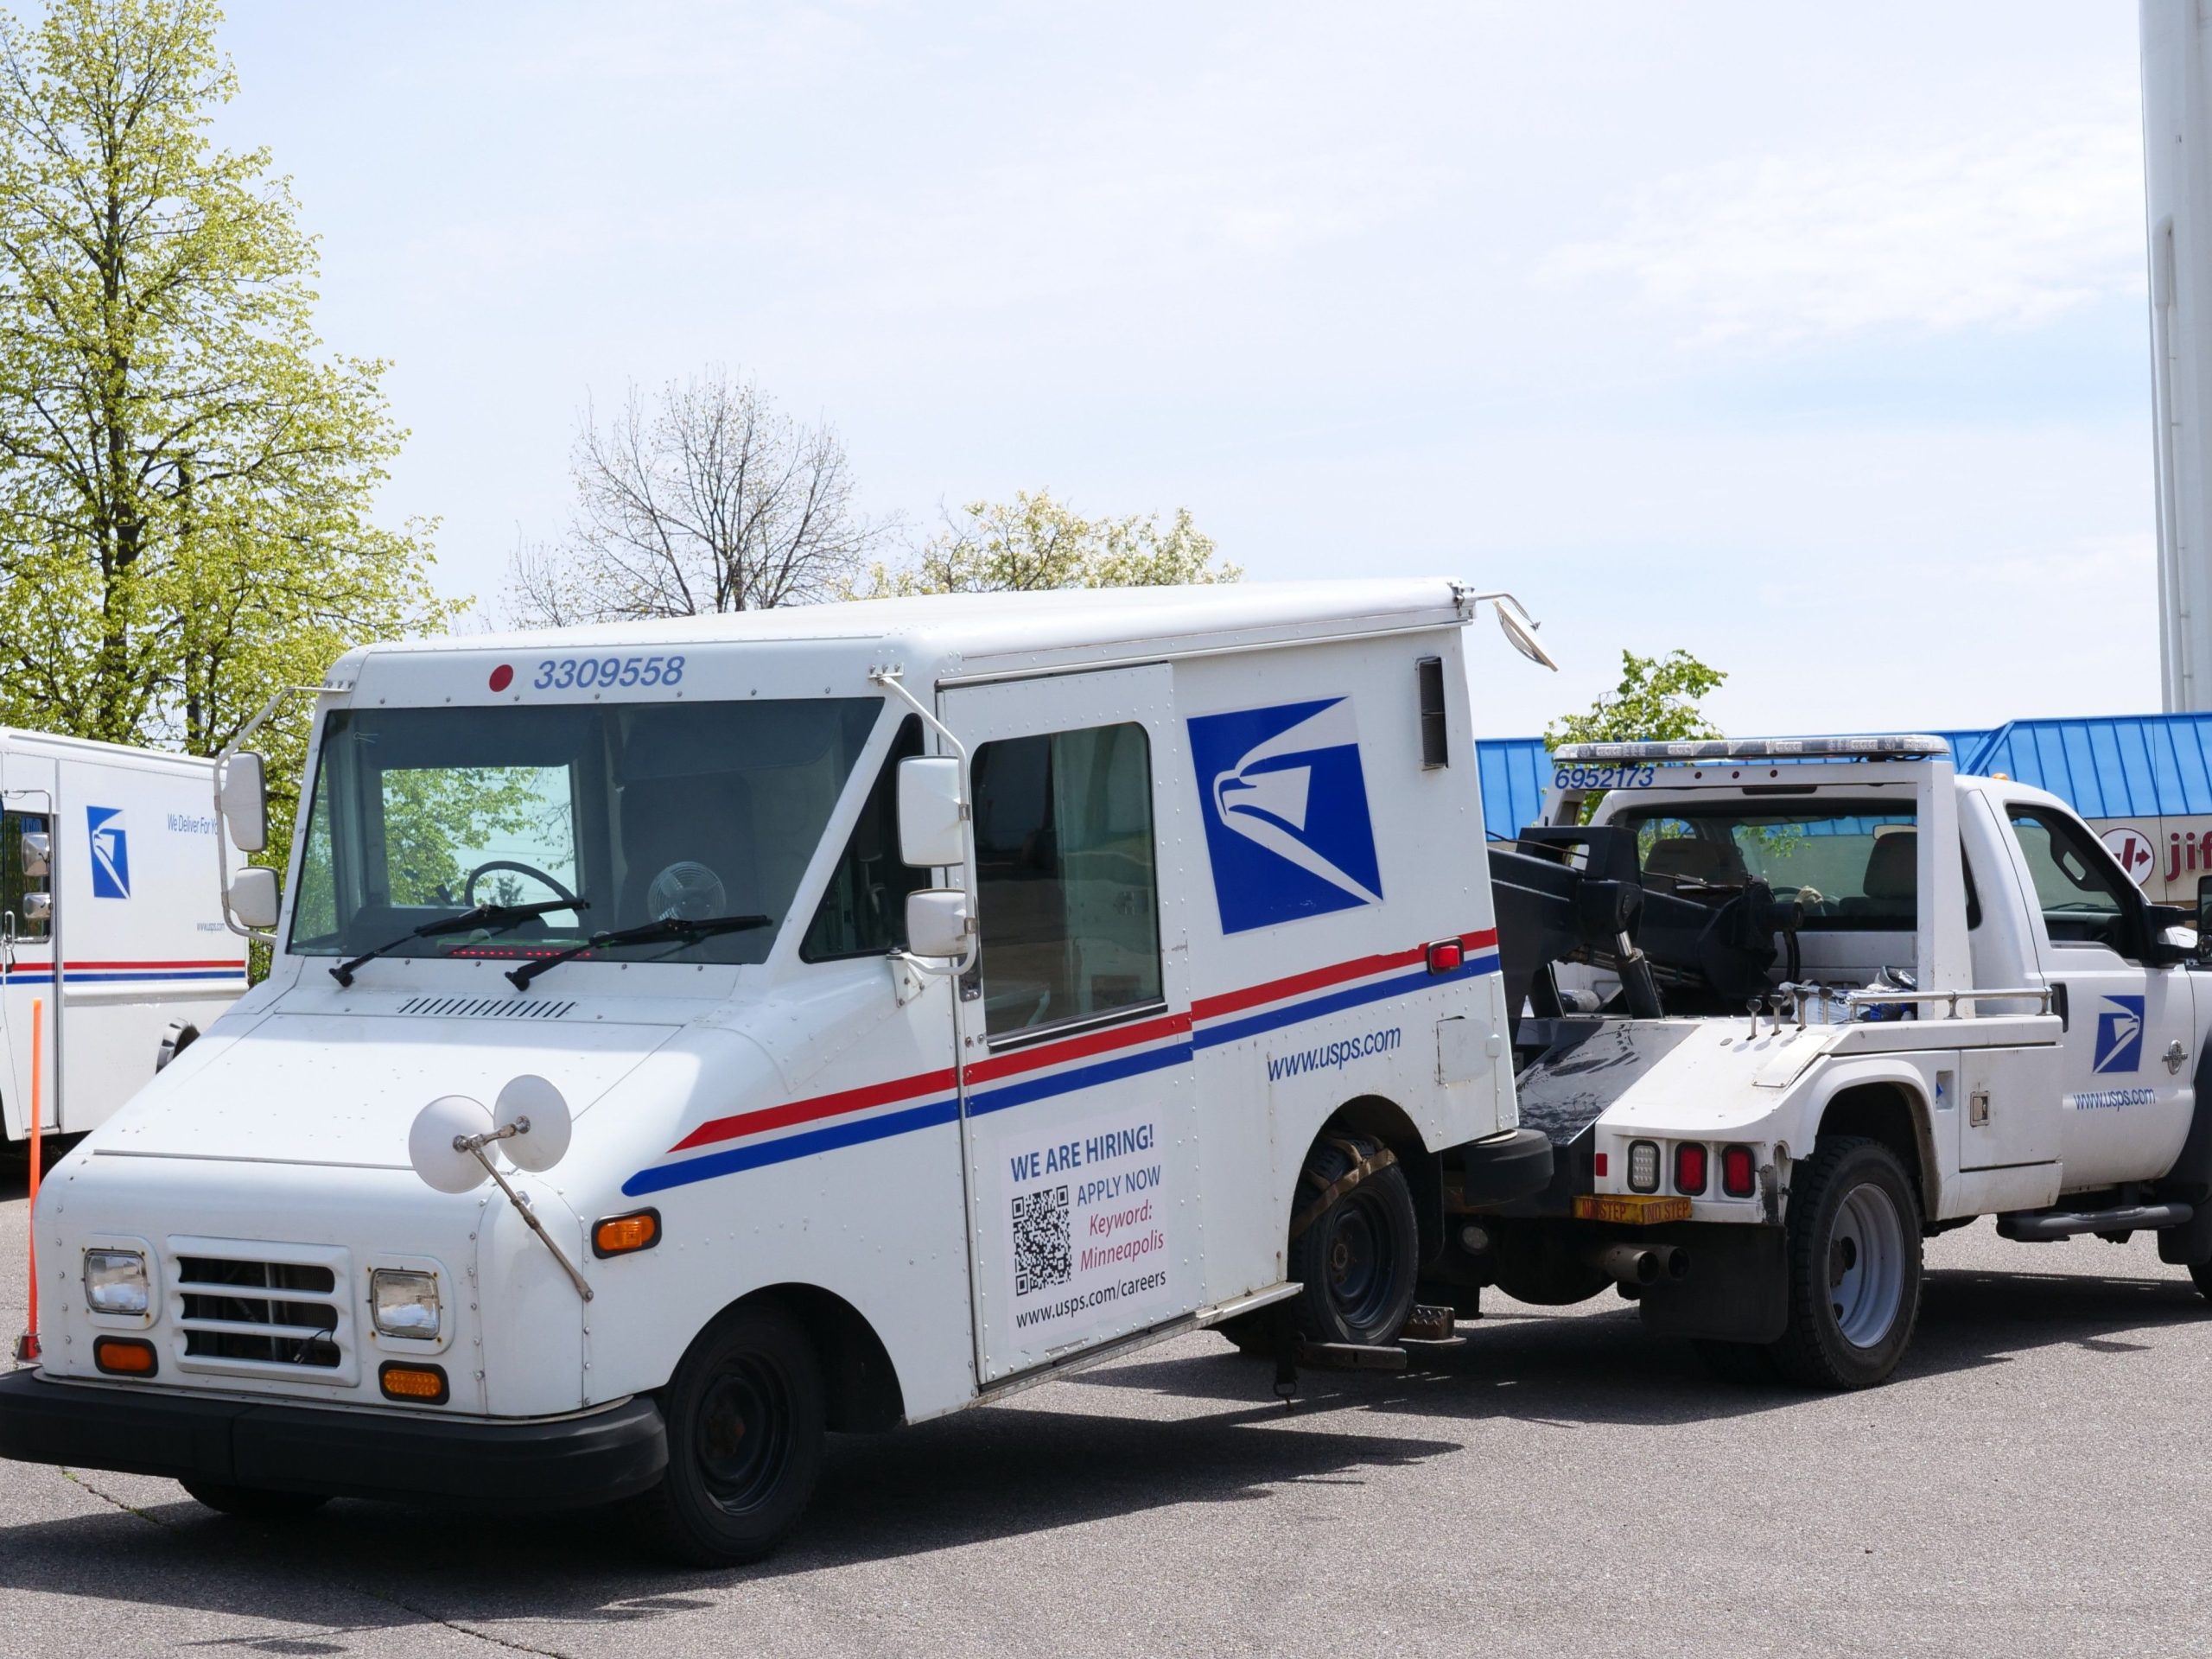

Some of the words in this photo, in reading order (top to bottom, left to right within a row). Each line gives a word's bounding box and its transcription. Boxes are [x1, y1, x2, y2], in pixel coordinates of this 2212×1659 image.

[534, 656, 685, 690] 3309558
[1555, 766, 1655, 789] 6952173
[168, 813, 177, 831] We
[179, 815, 199, 833] Deliver
[200, 817, 210, 835] For
[2165, 830, 2212, 882] jif
[1268, 1027, 1402, 1082] www.usps.com
[2074, 1088, 2156, 1112] www.usps.com
[1011, 1152, 1040, 1182] WE
[1046, 1141, 1082, 1174] ARE
[1086, 1123, 1154, 1164] HIRING!
[1077, 1175, 1122, 1206] APPLY
[1125, 1165, 1161, 1194] NOW
[1090, 1198, 1153, 1237] Keyword:
[1598, 1202, 1626, 1221] STEP
[1645, 1202, 1661, 1223] NO
[1664, 1200, 1689, 1218] STEP
[1080, 1230, 1164, 1272] Minneapolis
[1016, 1270, 1166, 1328] www.usps.com/careers
